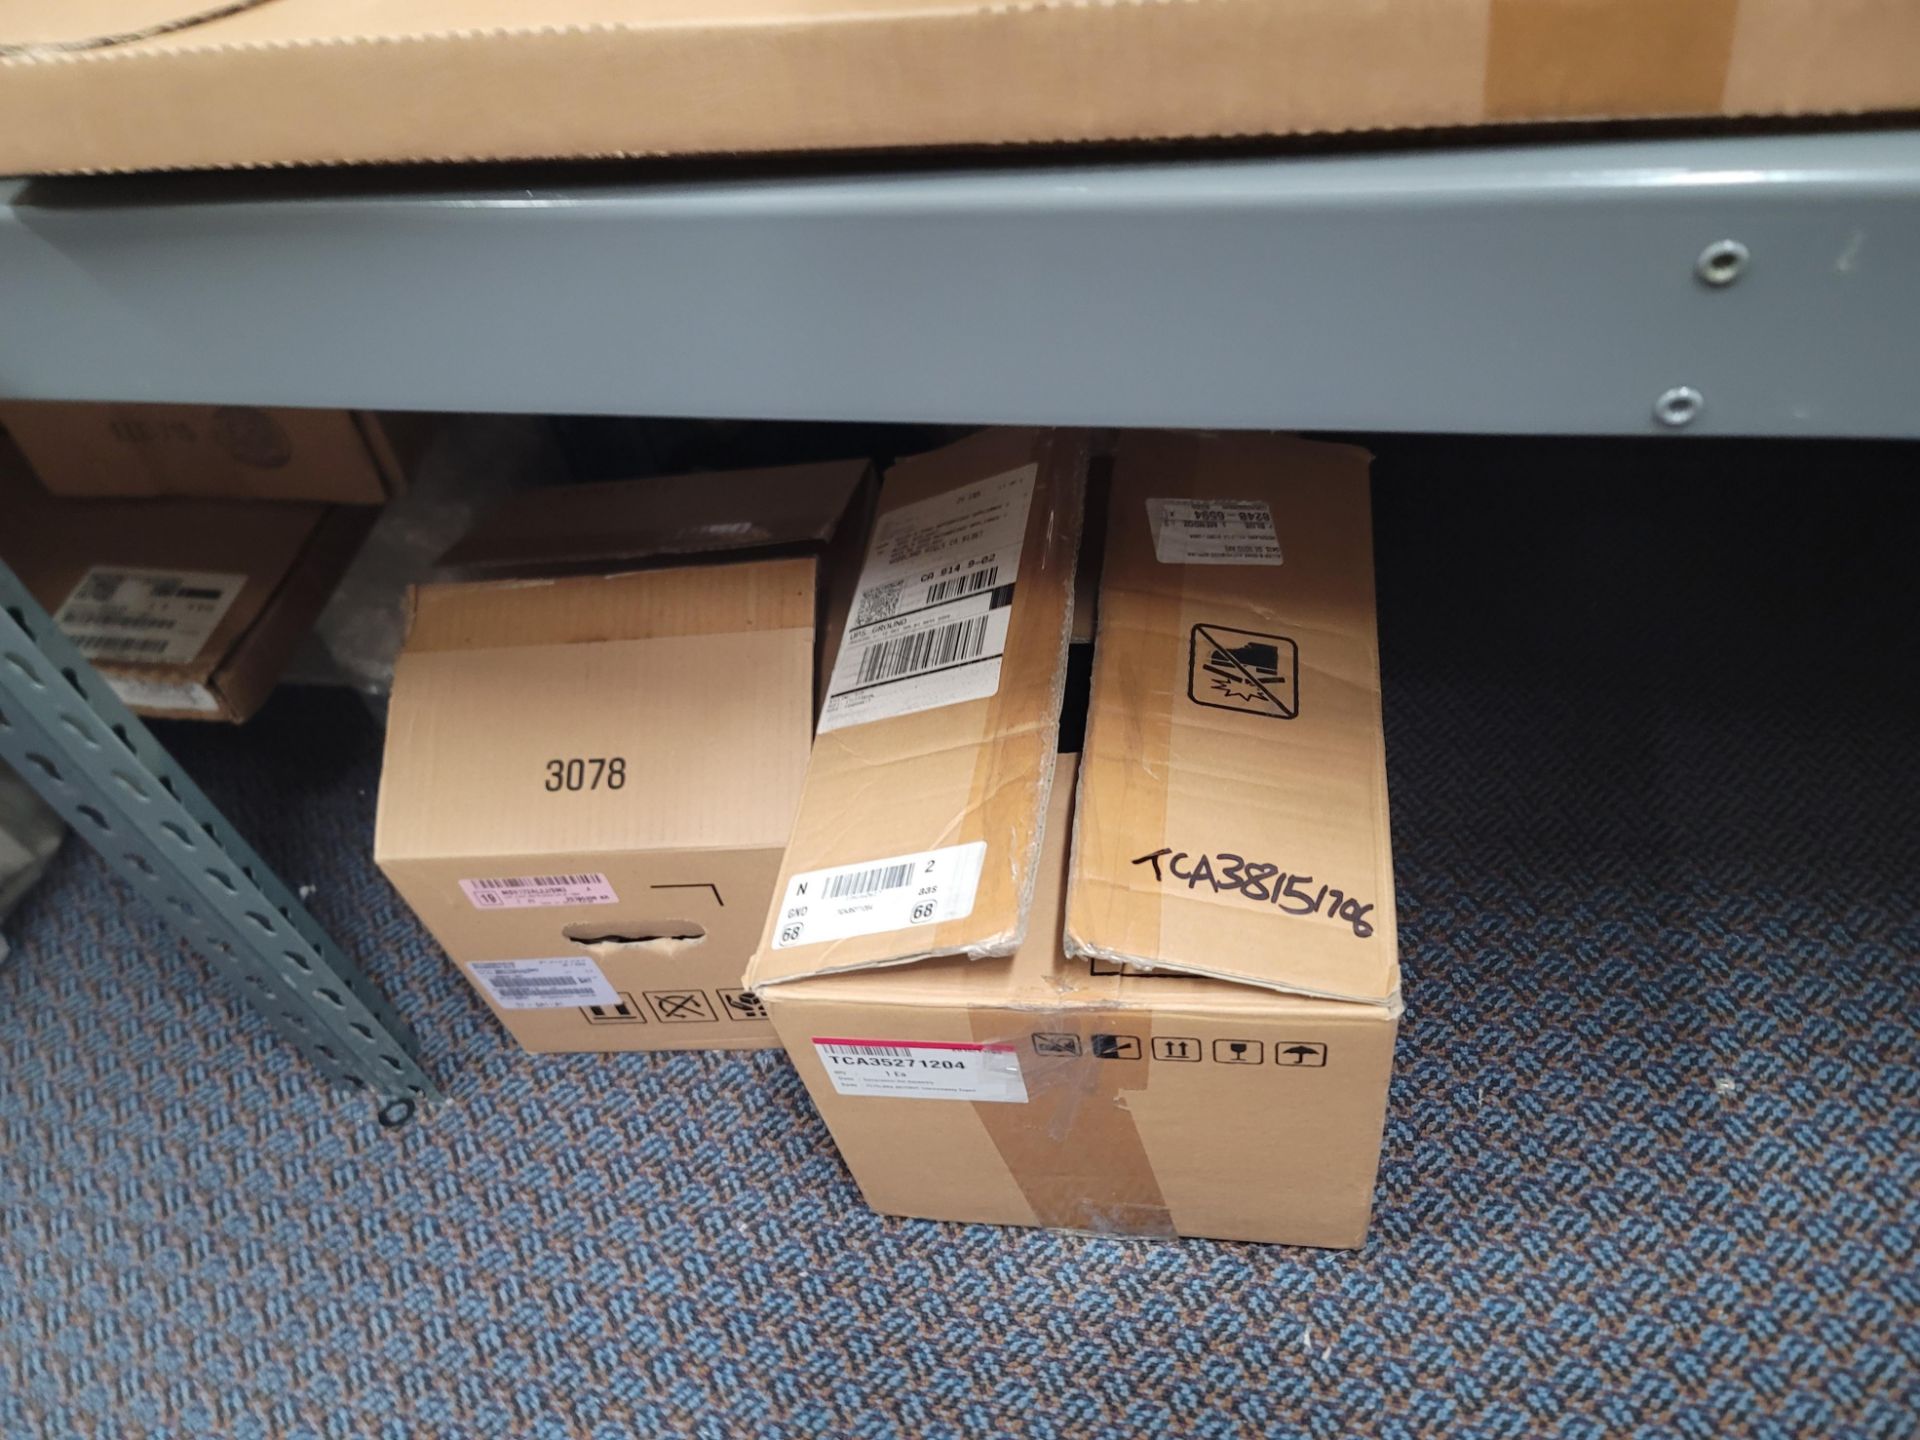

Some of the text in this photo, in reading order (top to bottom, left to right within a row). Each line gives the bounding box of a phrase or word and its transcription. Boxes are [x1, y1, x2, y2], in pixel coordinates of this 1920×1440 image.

[920, 571, 935, 584] CA
[871, 617, 907, 634] GROUND
[544, 757, 627, 792] 3078
[924, 859, 936, 874] 2
[795, 882, 809, 897] N
[1131, 848, 1375, 938] TCA38151706
[787, 905, 809, 919] GND
[913, 902, 934, 919] 68
[781, 926, 801, 942] 68
[827, 1055, 966, 1070] TCA35271204
